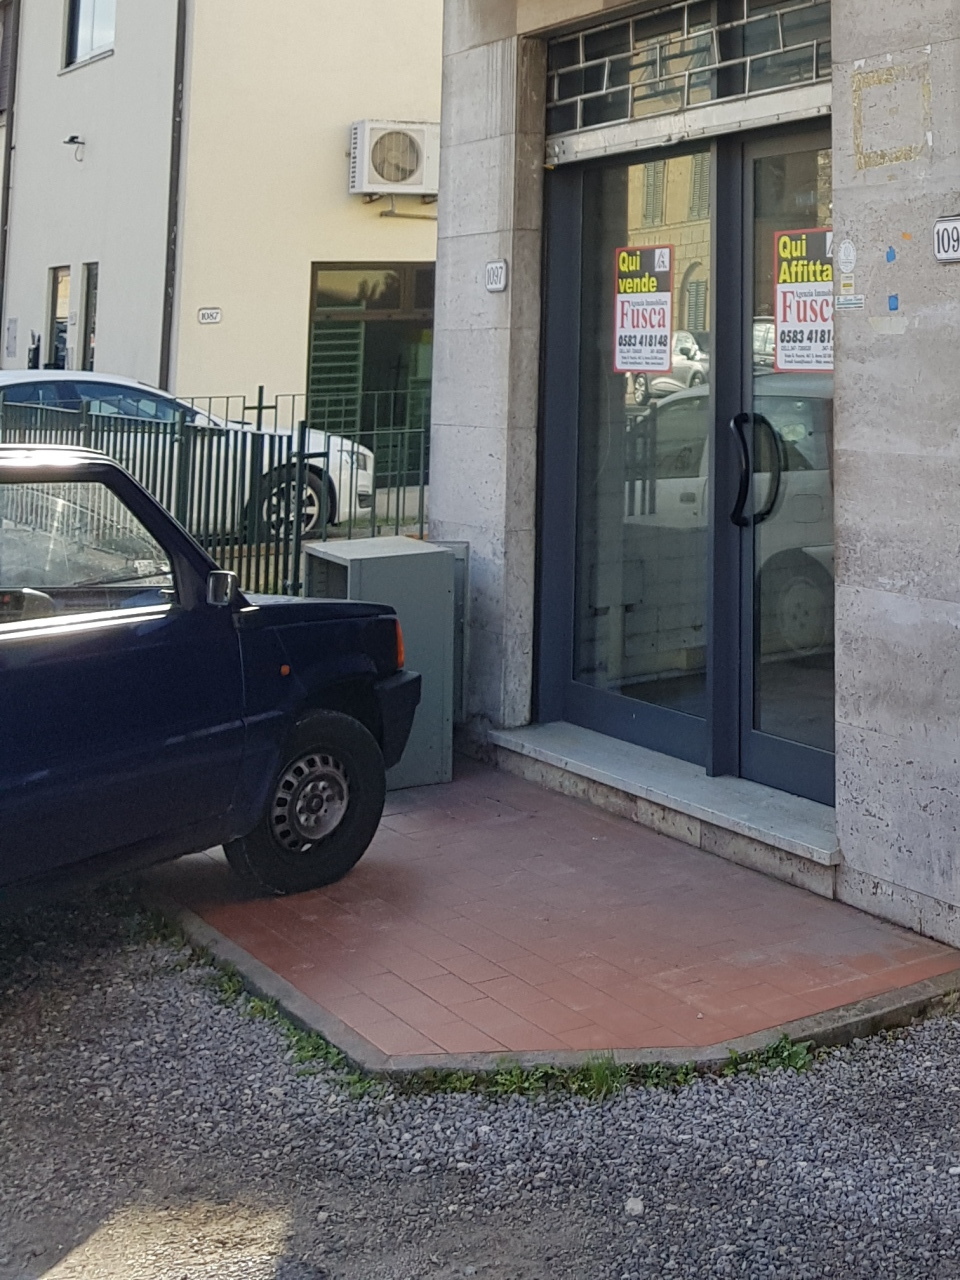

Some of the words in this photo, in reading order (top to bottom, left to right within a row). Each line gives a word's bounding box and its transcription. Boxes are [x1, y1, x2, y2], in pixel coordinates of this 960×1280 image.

[778, 234, 807, 258] Qui
[618, 251, 641, 272] Qui
[778, 260, 834, 284] Affitta
[486, 265, 504, 286] 1097
[618, 272, 658, 294] vende
[620, 300, 667, 329] Fusca
[780, 290, 834, 324] Fusc
[618, 335, 637, 348] 0583
[638, 334, 668, 348] 418148
[779, 329, 804, 344] 0583
[806, 328, 834, 344] 4181
